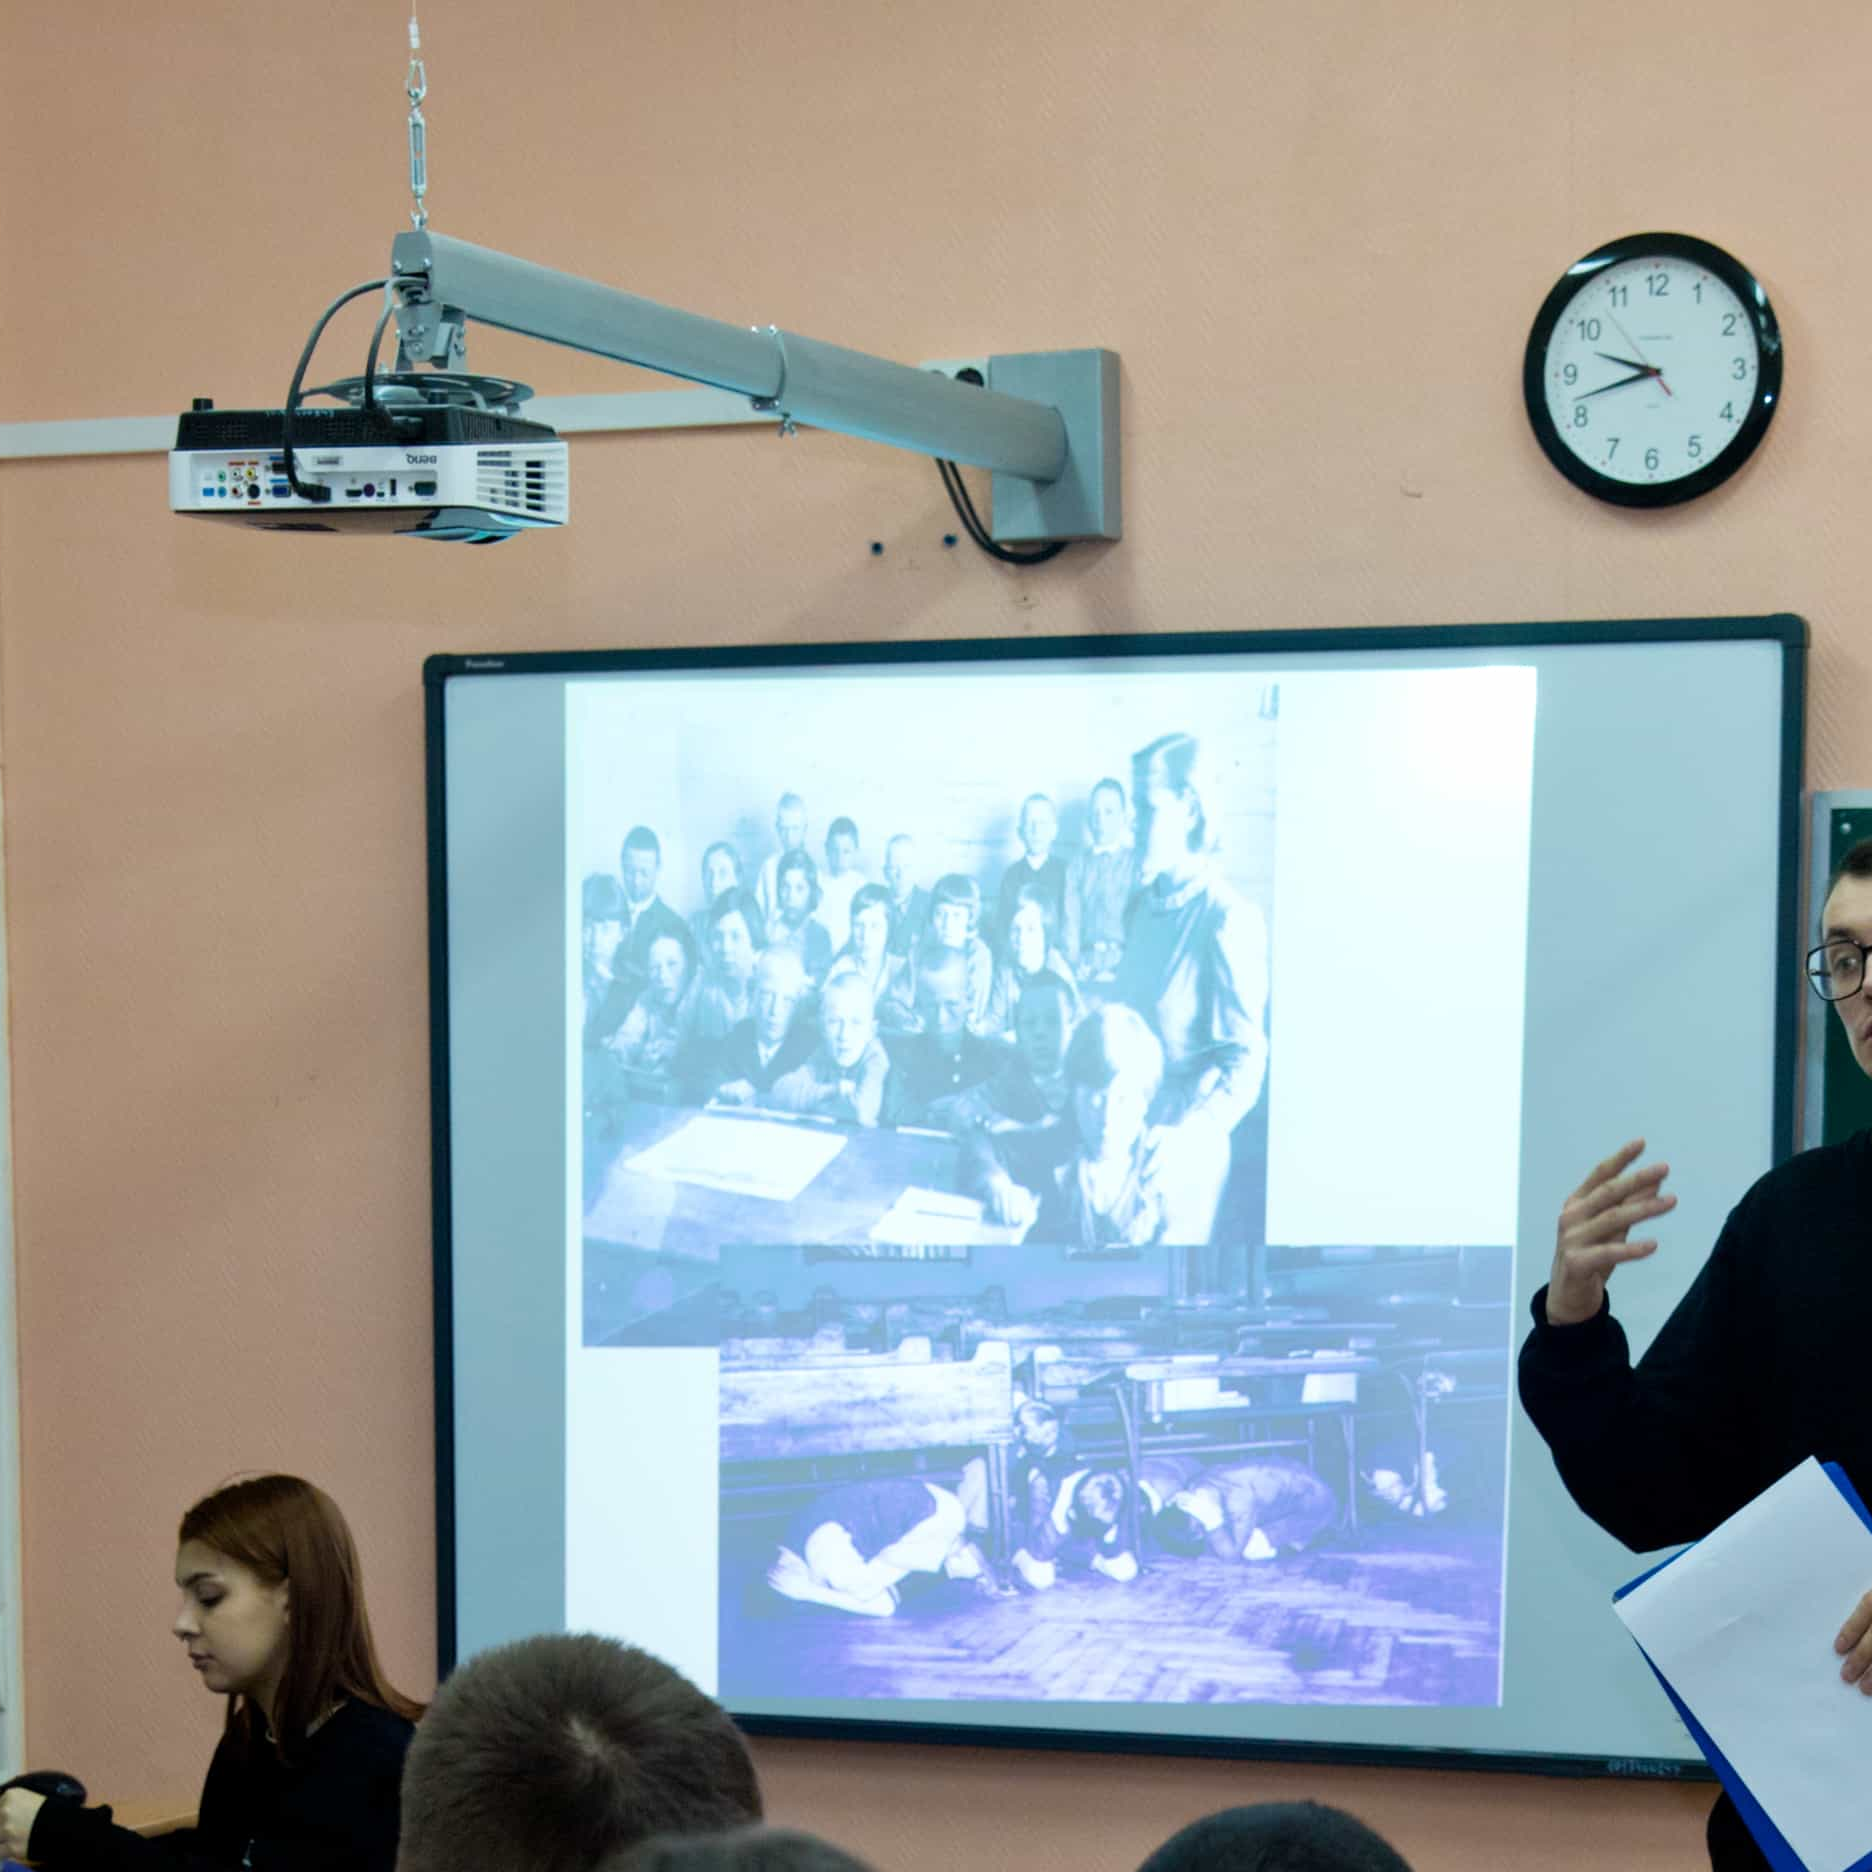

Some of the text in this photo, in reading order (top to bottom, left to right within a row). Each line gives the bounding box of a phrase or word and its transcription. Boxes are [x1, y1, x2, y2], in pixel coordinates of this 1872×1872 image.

[1608, 285, 1628, 308] 11
[1645, 274, 1669, 296] 12
[1692, 282, 1701, 304] 1
[1576, 318, 1601, 342] 10
[1721, 313, 1737, 336] 2
[1563, 364, 1578, 385] 9
[1732, 358, 1747, 381] 3
[1574, 405, 1588, 428] 8
[1720, 401, 1734, 422] 4
[1607, 438, 1621, 459] 7
[1687, 434, 1702, 458] 5
[1644, 448, 1659, 471] 6
